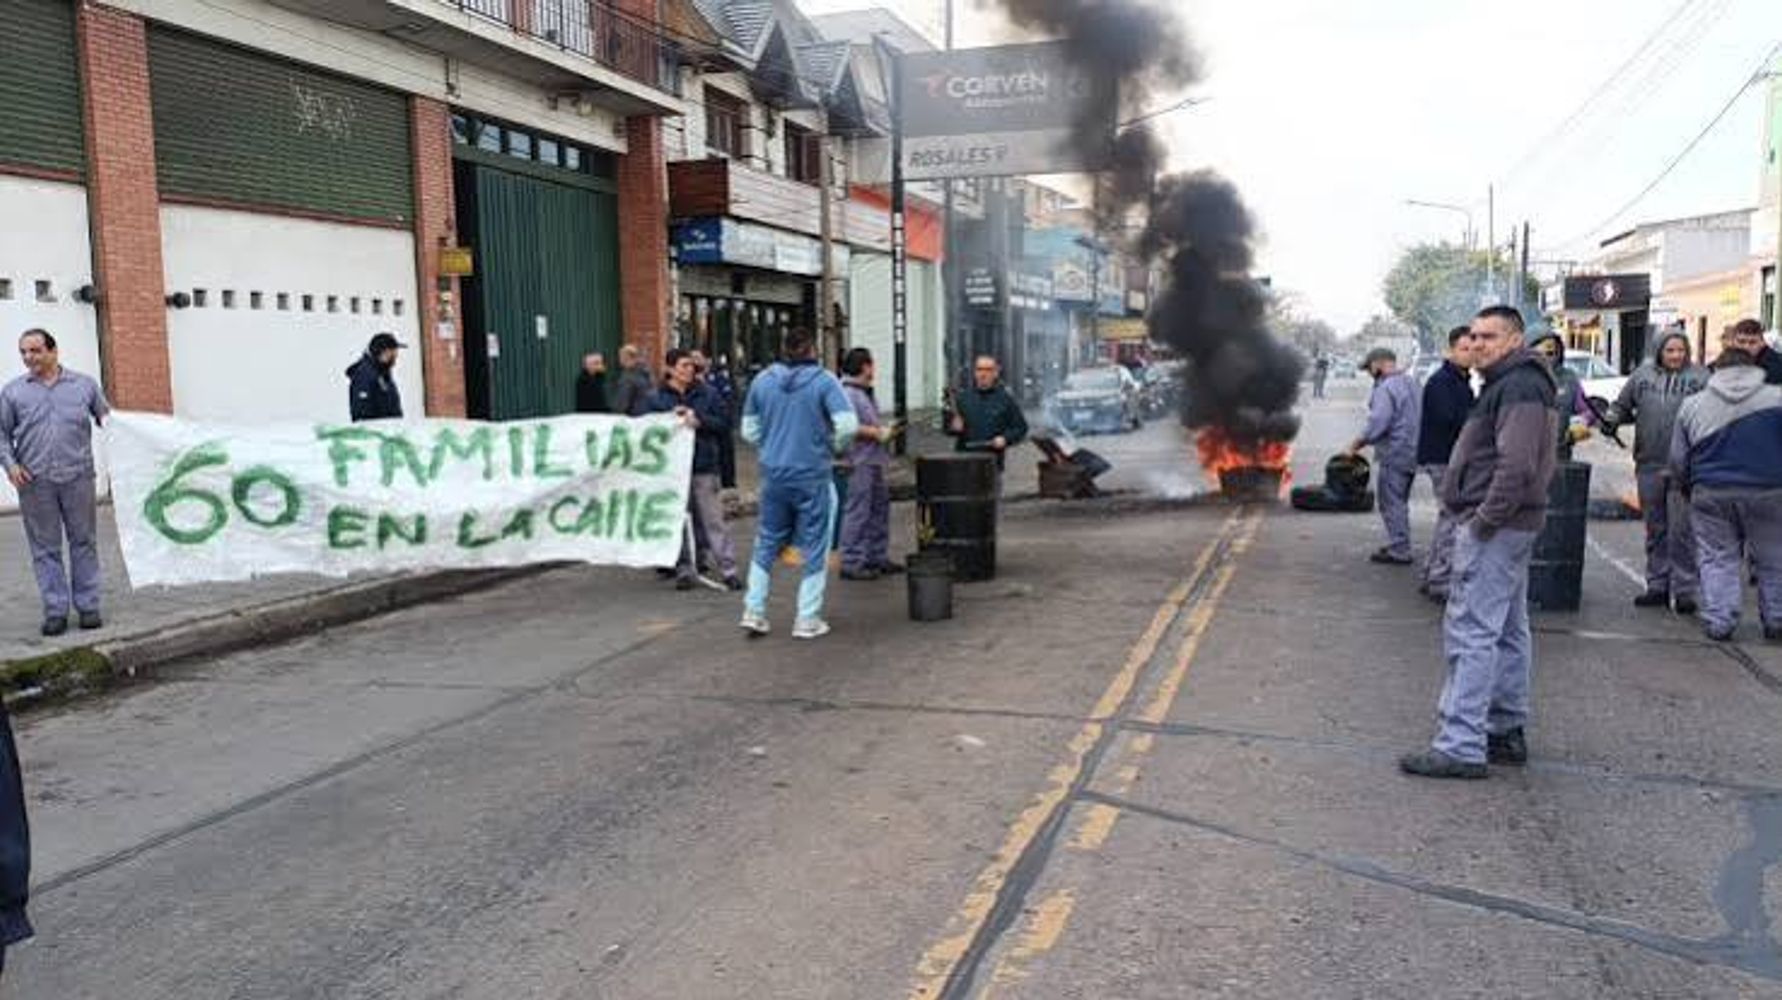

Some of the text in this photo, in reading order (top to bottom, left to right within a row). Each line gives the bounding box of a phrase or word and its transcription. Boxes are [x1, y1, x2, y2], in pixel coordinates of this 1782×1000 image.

[316, 424, 672, 487] FAMILIAS
[144, 440, 300, 544] 60
[328, 506, 428, 550] EN
[457, 508, 533, 548] LA
